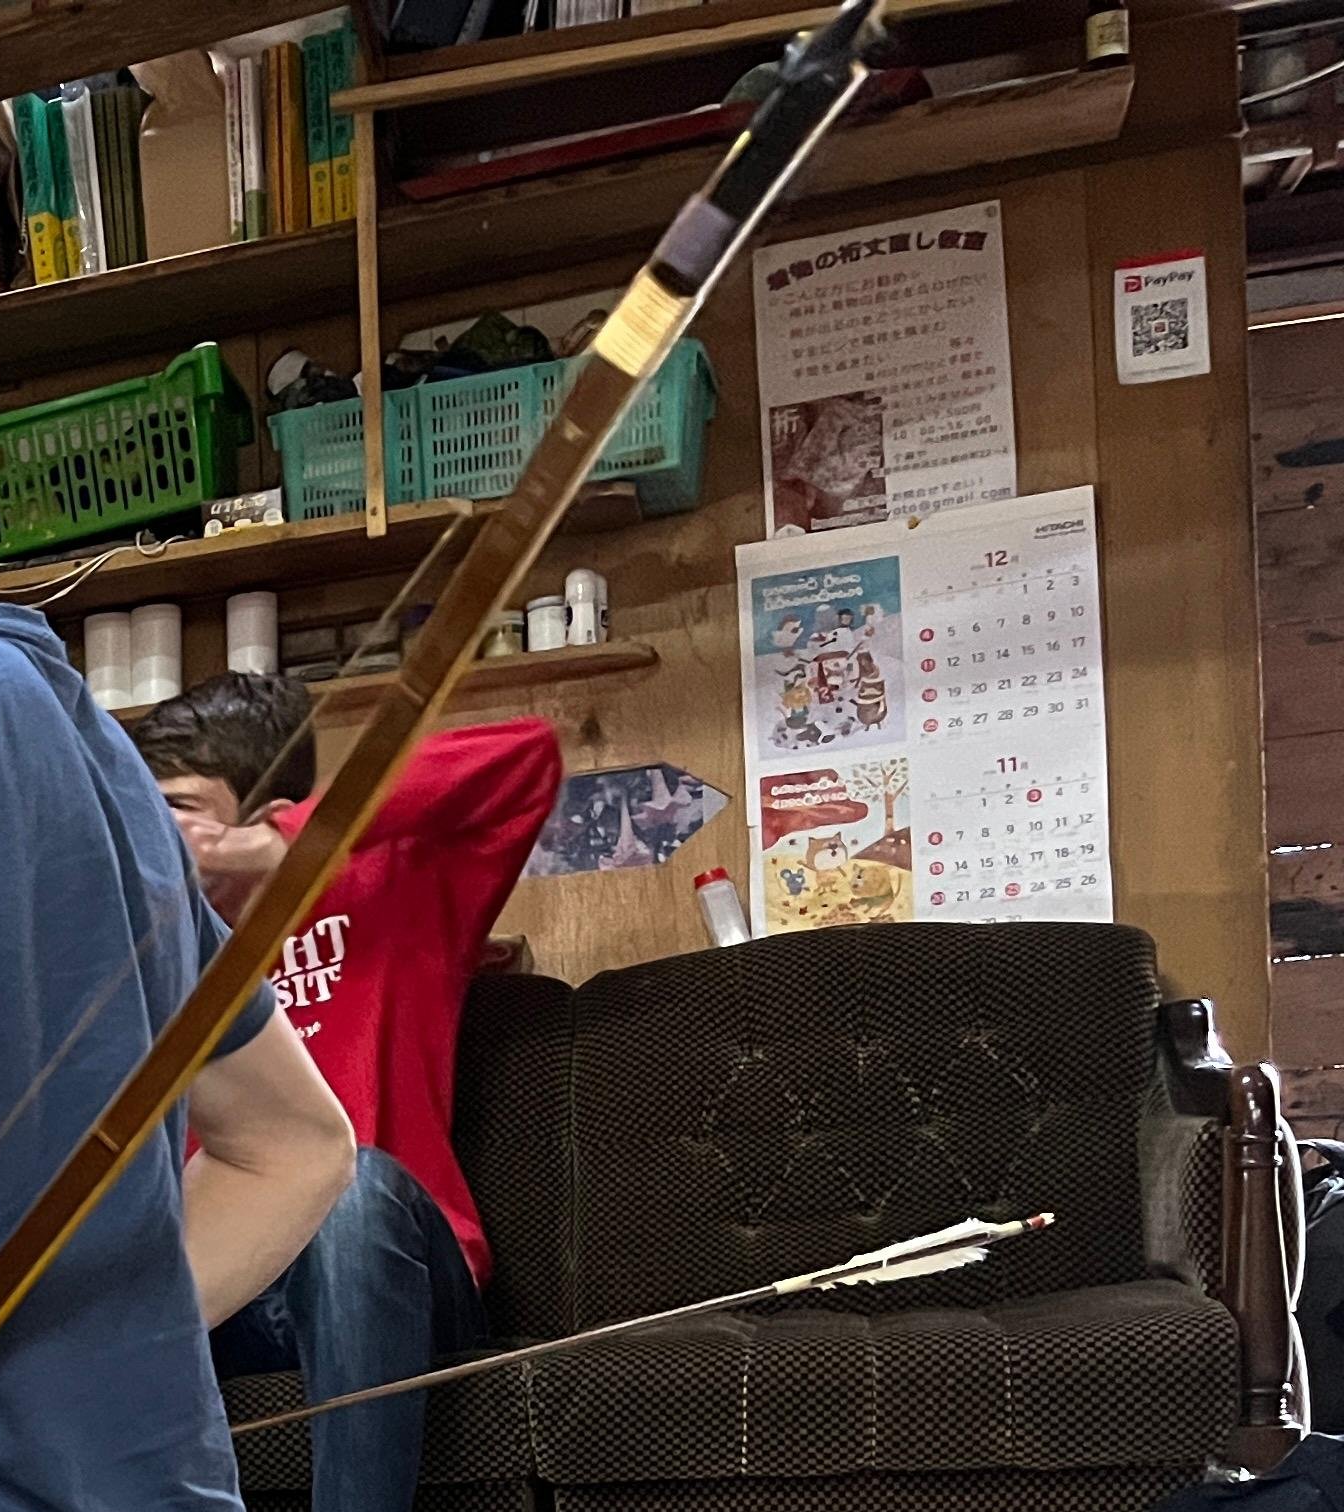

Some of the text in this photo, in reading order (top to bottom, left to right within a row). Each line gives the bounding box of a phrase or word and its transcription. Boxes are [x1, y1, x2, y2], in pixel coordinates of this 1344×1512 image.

[1144, 270, 1195, 288] PayPay
[984, 550, 1009, 568] 12
[1046, 580, 1055, 591] 2
[1071, 575, 1080, 586] 3
[947, 626, 956, 637] 5
[972, 622, 981, 633] 6
[997, 618, 1005, 628] 7
[1022, 614, 1031, 625] 8
[1047, 610, 1056, 621] 9
[1070, 605, 1084, 617] 10
[947, 656, 960, 667] 12
[972, 652, 985, 663] 13
[996, 649, 1010, 659] 14
[1021, 645, 1035, 656] 15
[1046, 641, 1060, 651] 16
[1071, 636, 1085, 648] 17
[947, 686, 962, 697] 19
[972, 682, 988, 694] 20
[997, 679, 1012, 690] 21
[1021, 675, 1037, 686] 22
[1046, 671, 1063, 683] 23
[1071, 667, 1088, 679] 24
[947, 717, 963, 728] 26
[973, 713, 988, 724] 27
[997, 709, 1014, 721] 28
[1022, 705, 1039, 717] 29
[1047, 702, 1064, 714] 30
[1075, 698, 1089, 710] 31
[996, 757, 1017, 773] 11
[1004, 794, 1013, 805] 2
[1055, 787, 1064, 796] 4
[1080, 783, 1089, 793] 5
[956, 831, 964, 840] 7
[981, 827, 990, 838] 8
[1006, 824, 1015, 835] 9
[1028, 821, 1043, 831] 10
[1055, 817, 1068, 827] 11
[1079, 813, 1093, 824] 12
[954, 861, 968, 871] 14
[980, 857, 994, 868] 15
[1004, 855, 1019, 865] 16
[1030, 851, 1043, 862] 17
[1055, 848, 1070, 858] 18
[1079, 844, 1094, 855] 19
[956, 891, 970, 902] 21
[979, 888, 996, 899] 22
[1030, 882, 1047, 892] 24
[1055, 878, 1071, 889] 25
[1080, 874, 1097, 885] 26
[274, 914, 350, 982] HT
